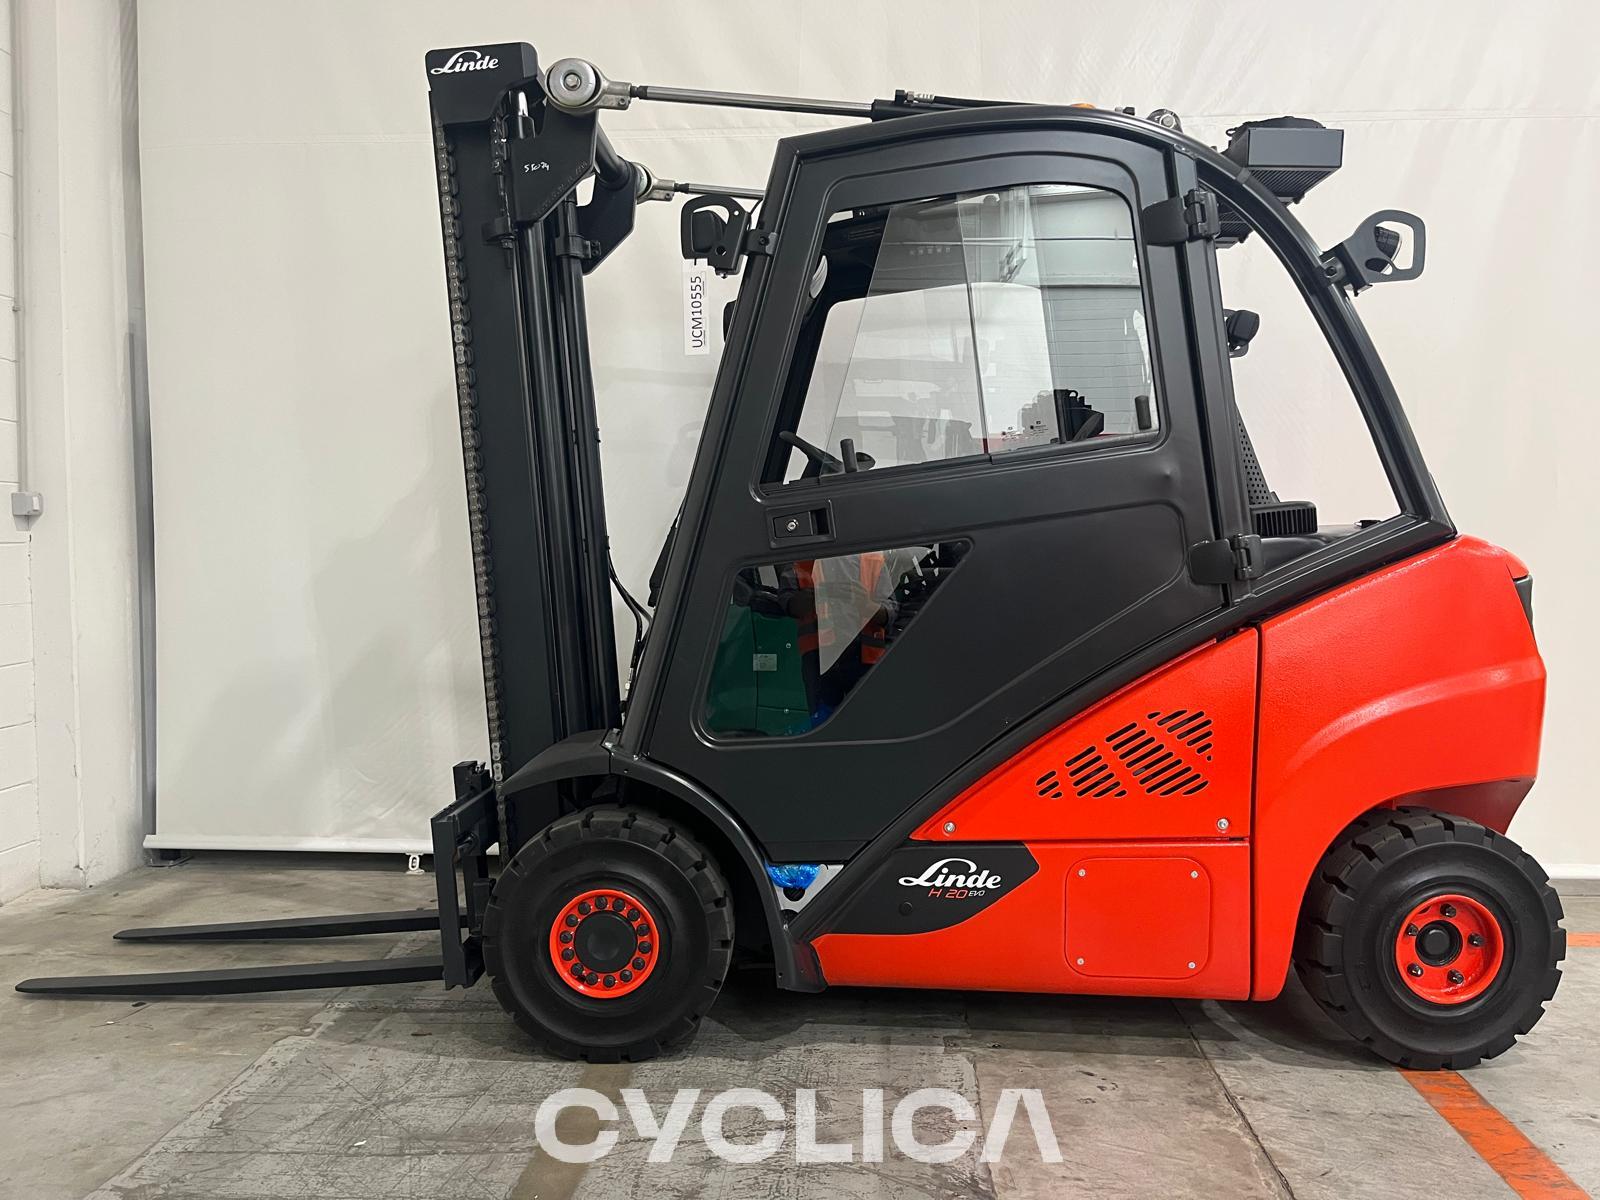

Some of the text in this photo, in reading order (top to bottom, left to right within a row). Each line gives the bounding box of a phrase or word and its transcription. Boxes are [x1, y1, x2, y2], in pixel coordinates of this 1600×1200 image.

[430, 50, 499, 75] Linde
[690, 275, 703, 348] UCM10555
[898, 857, 1002, 889] Linde
[928, 887, 943, 898] H
[945, 889, 969, 899] 20
